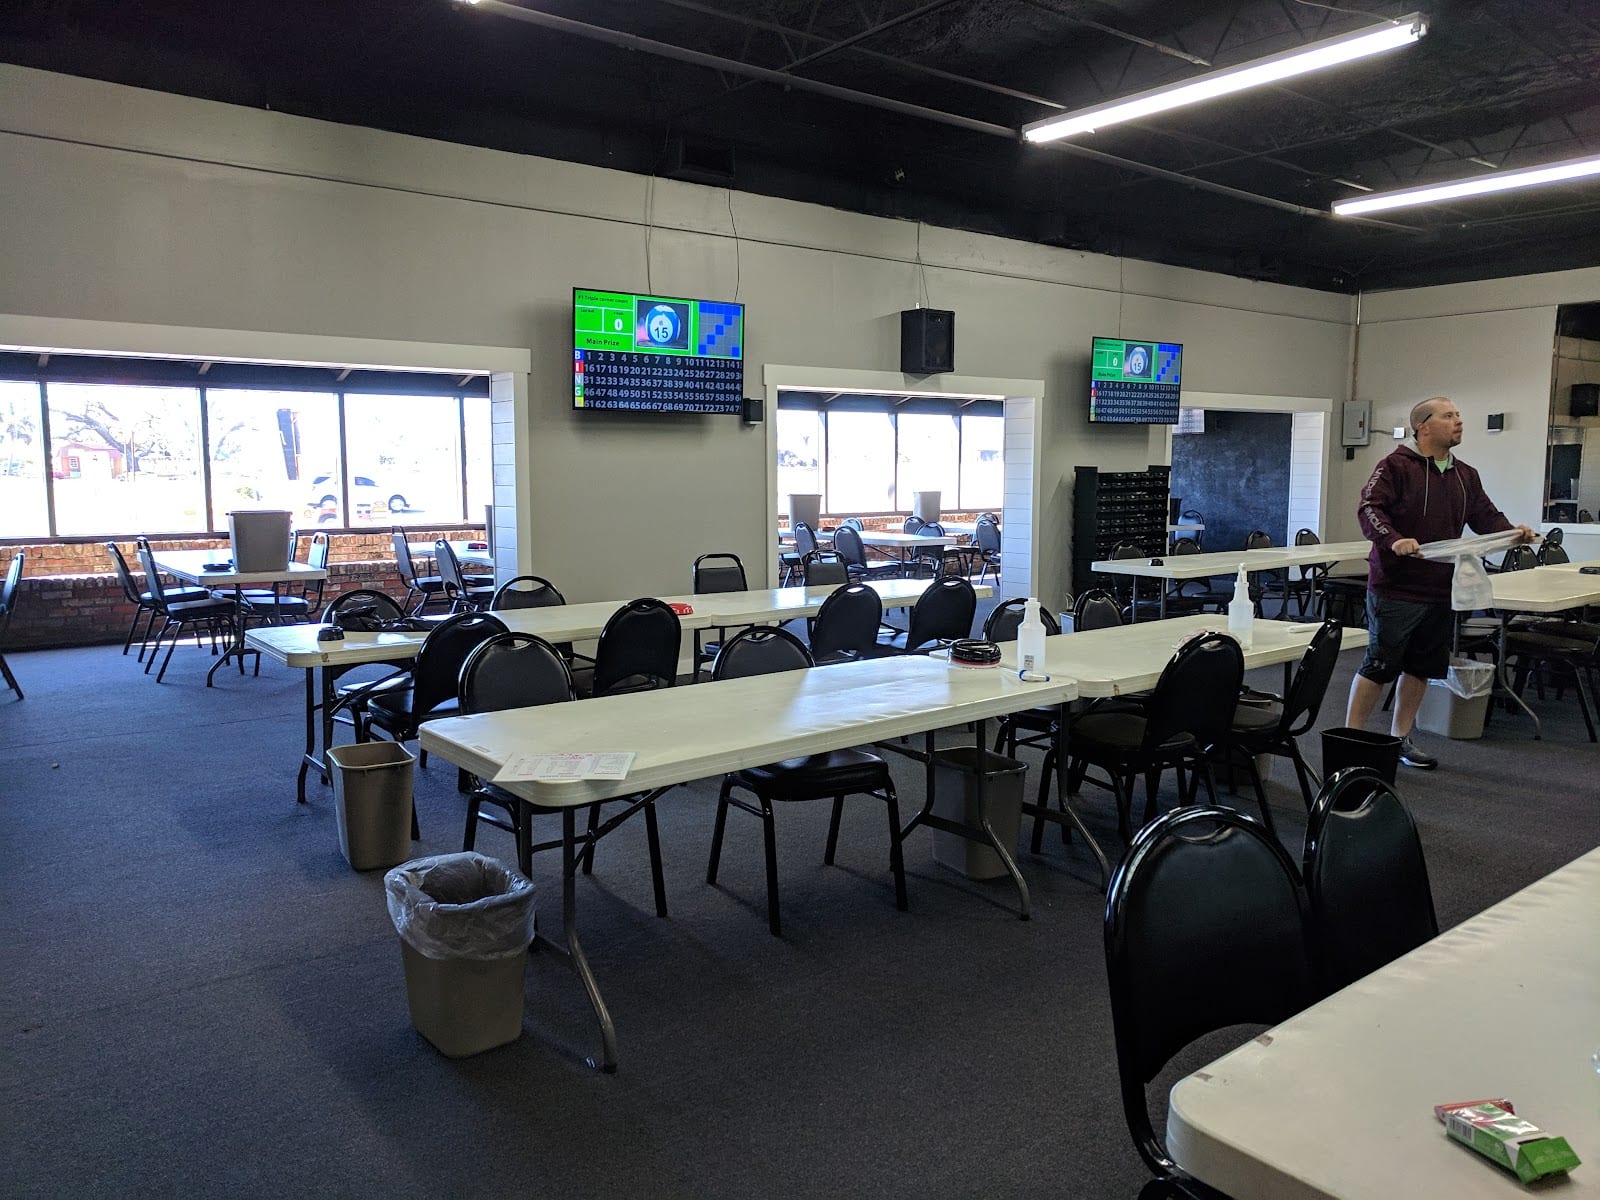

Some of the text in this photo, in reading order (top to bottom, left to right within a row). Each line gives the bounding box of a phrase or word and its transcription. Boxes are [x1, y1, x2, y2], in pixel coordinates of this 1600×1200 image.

[614, 318, 622, 330] 0
[654, 327, 668, 338] 15
[575, 351, 580, 359] B
[576, 362, 579, 372] I
[1134, 362, 1142, 371] 15
[575, 387, 580, 396] G
[584, 388, 595, 396] 46
[596, 388, 606, 397] 47
[607, 389, 617, 397] 48
[619, 389, 629, 397] 49
[1364, 467, 1384, 498] UNDE
